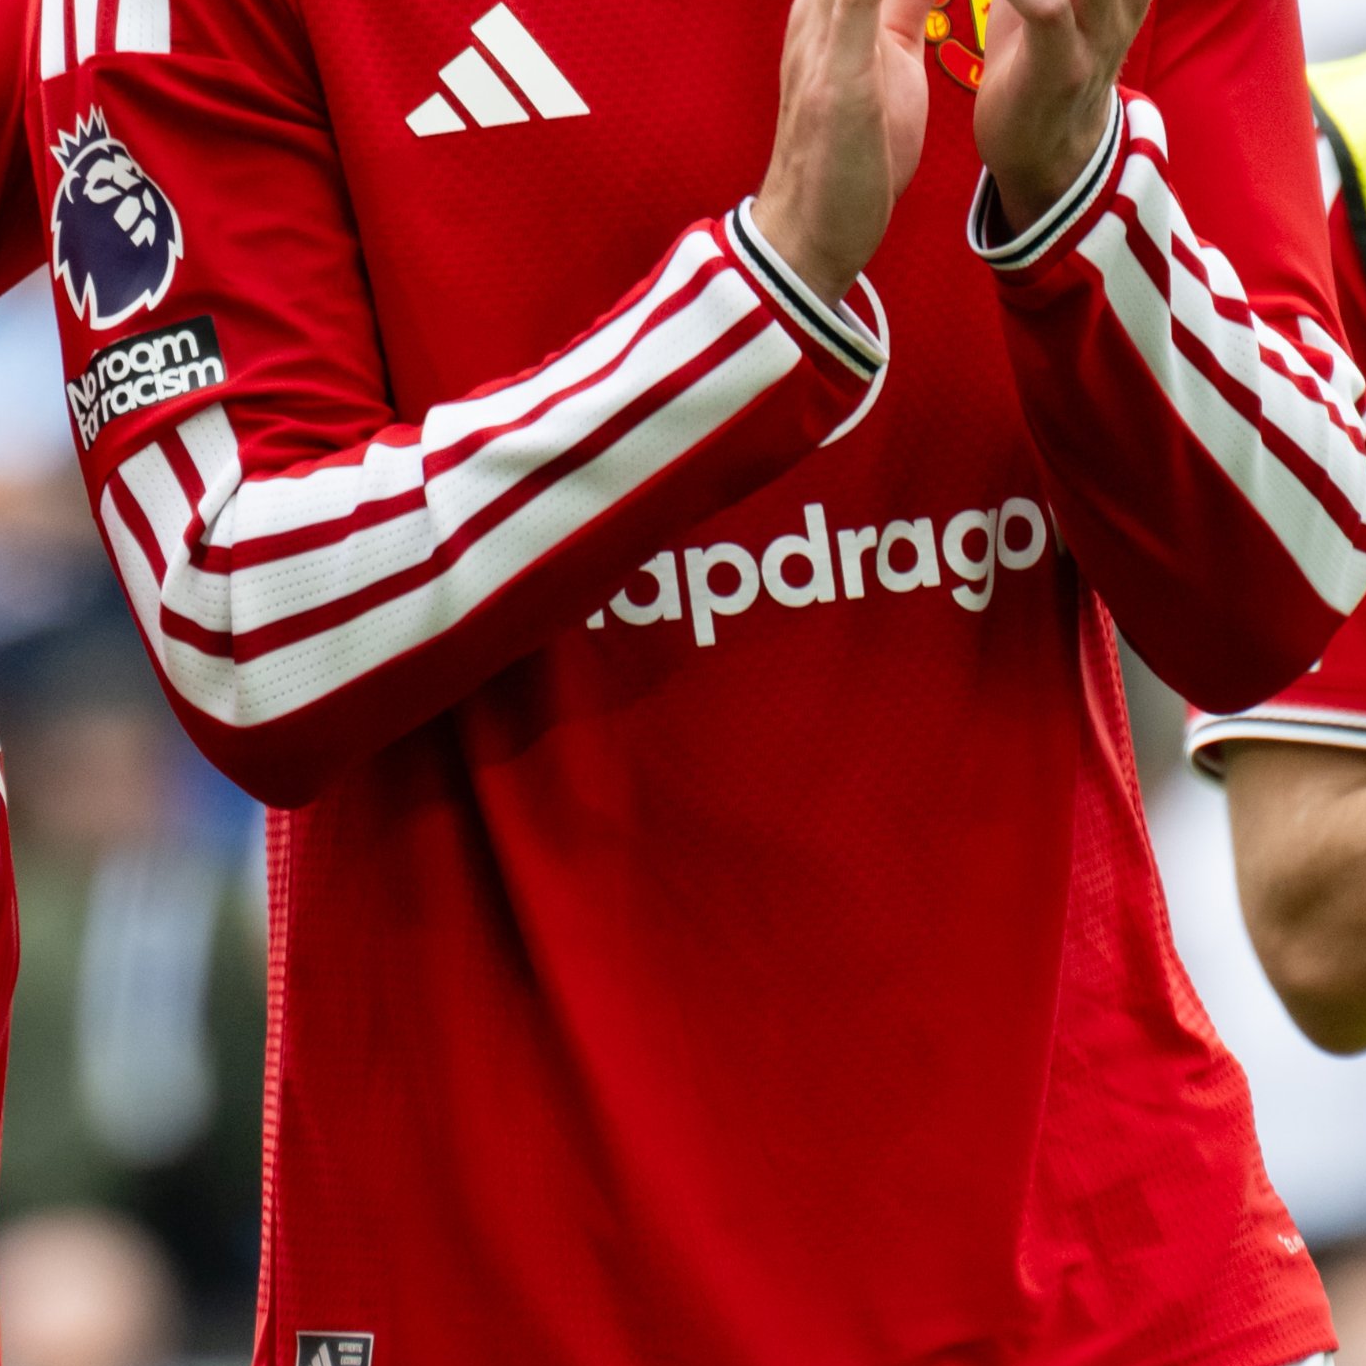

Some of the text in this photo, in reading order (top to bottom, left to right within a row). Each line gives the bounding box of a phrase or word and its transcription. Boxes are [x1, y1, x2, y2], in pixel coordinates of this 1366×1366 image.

[66, 330, 200, 420] No room
[101, 357, 224, 423] racism
[586, 497, 1065, 647] apdrago
